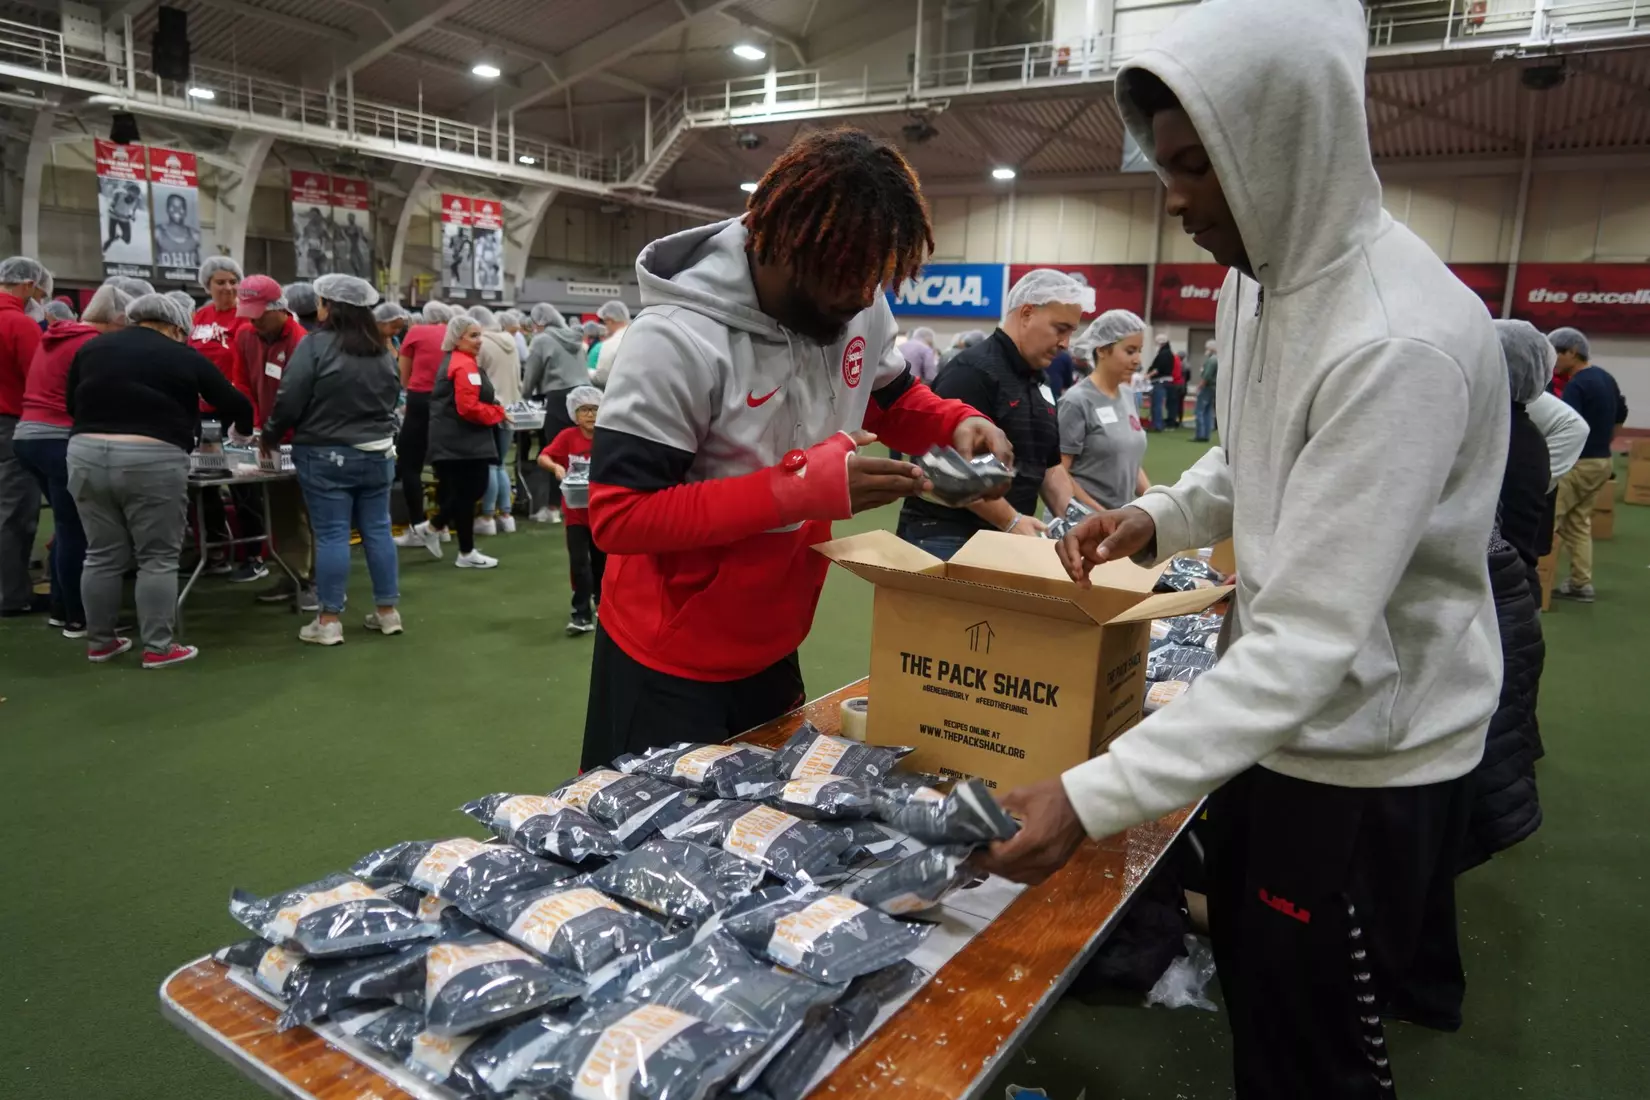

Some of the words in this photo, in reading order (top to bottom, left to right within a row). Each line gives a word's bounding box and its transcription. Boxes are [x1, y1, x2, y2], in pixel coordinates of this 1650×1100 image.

[894, 275, 982, 306] NCAA
[1181, 284, 1211, 298] the
[1528, 288, 1568, 303] the
[900, 652, 933, 679] THE
[937, 660, 988, 691] PACK
[993, 673, 1060, 707] SHACK
[975, 696, 1029, 716] #FEEDTHEFUNNEL
[943, 719, 968, 732] RECIPES
[969, 725, 990, 737] ONLINE
[991, 731, 1001, 740] AT
[919, 724, 1026, 759] WWW.THEPACKSHACK.ORG
[939, 767, 963, 780] APPROX
[985, 779, 998, 789] LBS
